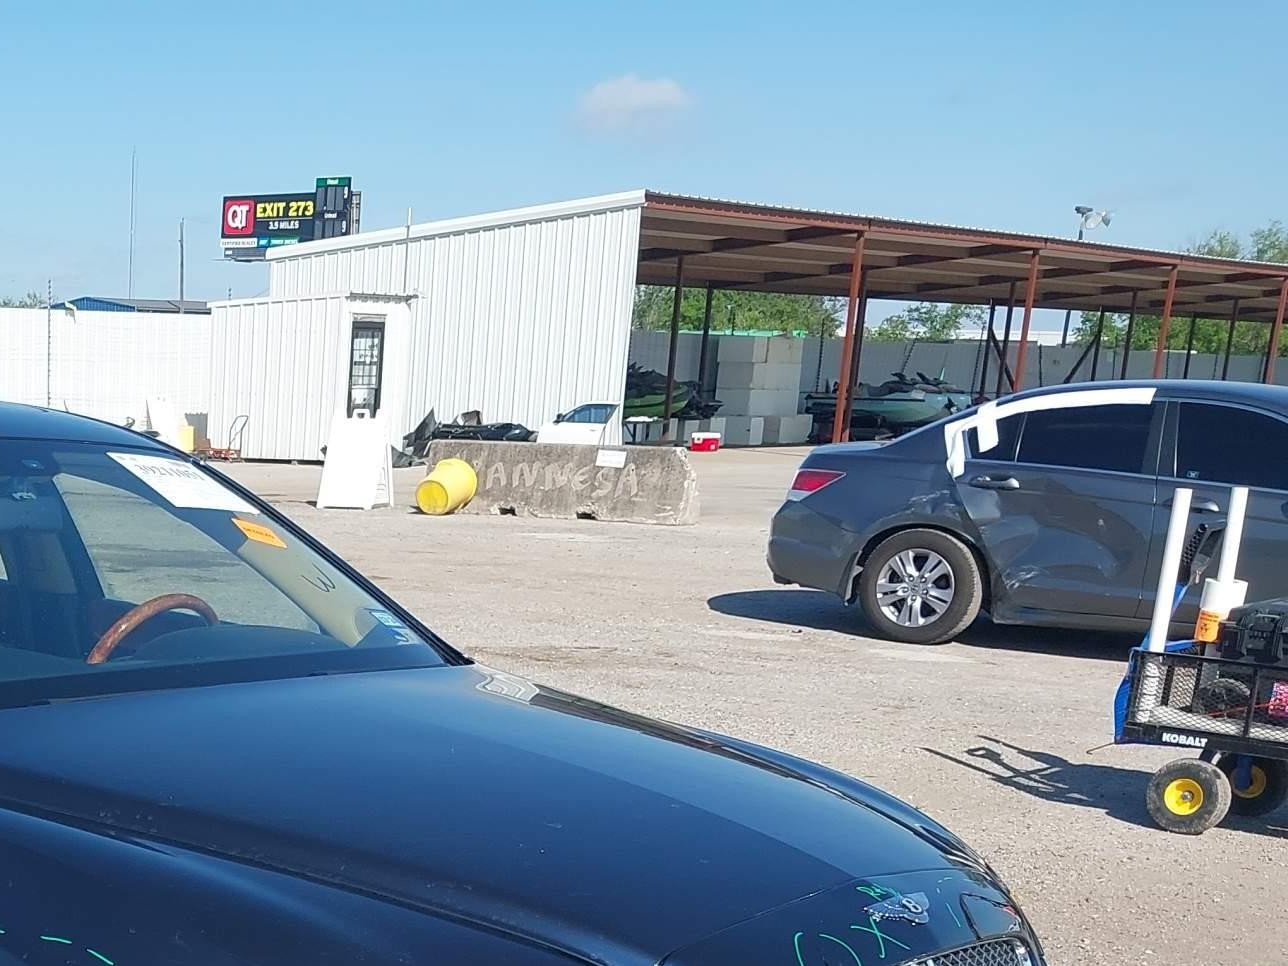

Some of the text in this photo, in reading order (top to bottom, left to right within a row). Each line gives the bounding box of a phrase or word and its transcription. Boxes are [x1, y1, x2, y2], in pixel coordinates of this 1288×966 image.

[227, 204, 250, 231] QT
[256, 200, 314, 218] EXIT 273
[268, 220, 300, 230] 3.5 MILES
[470, 460, 639, 499] ANNESA
[1161, 732, 1209, 748] KOBALT
